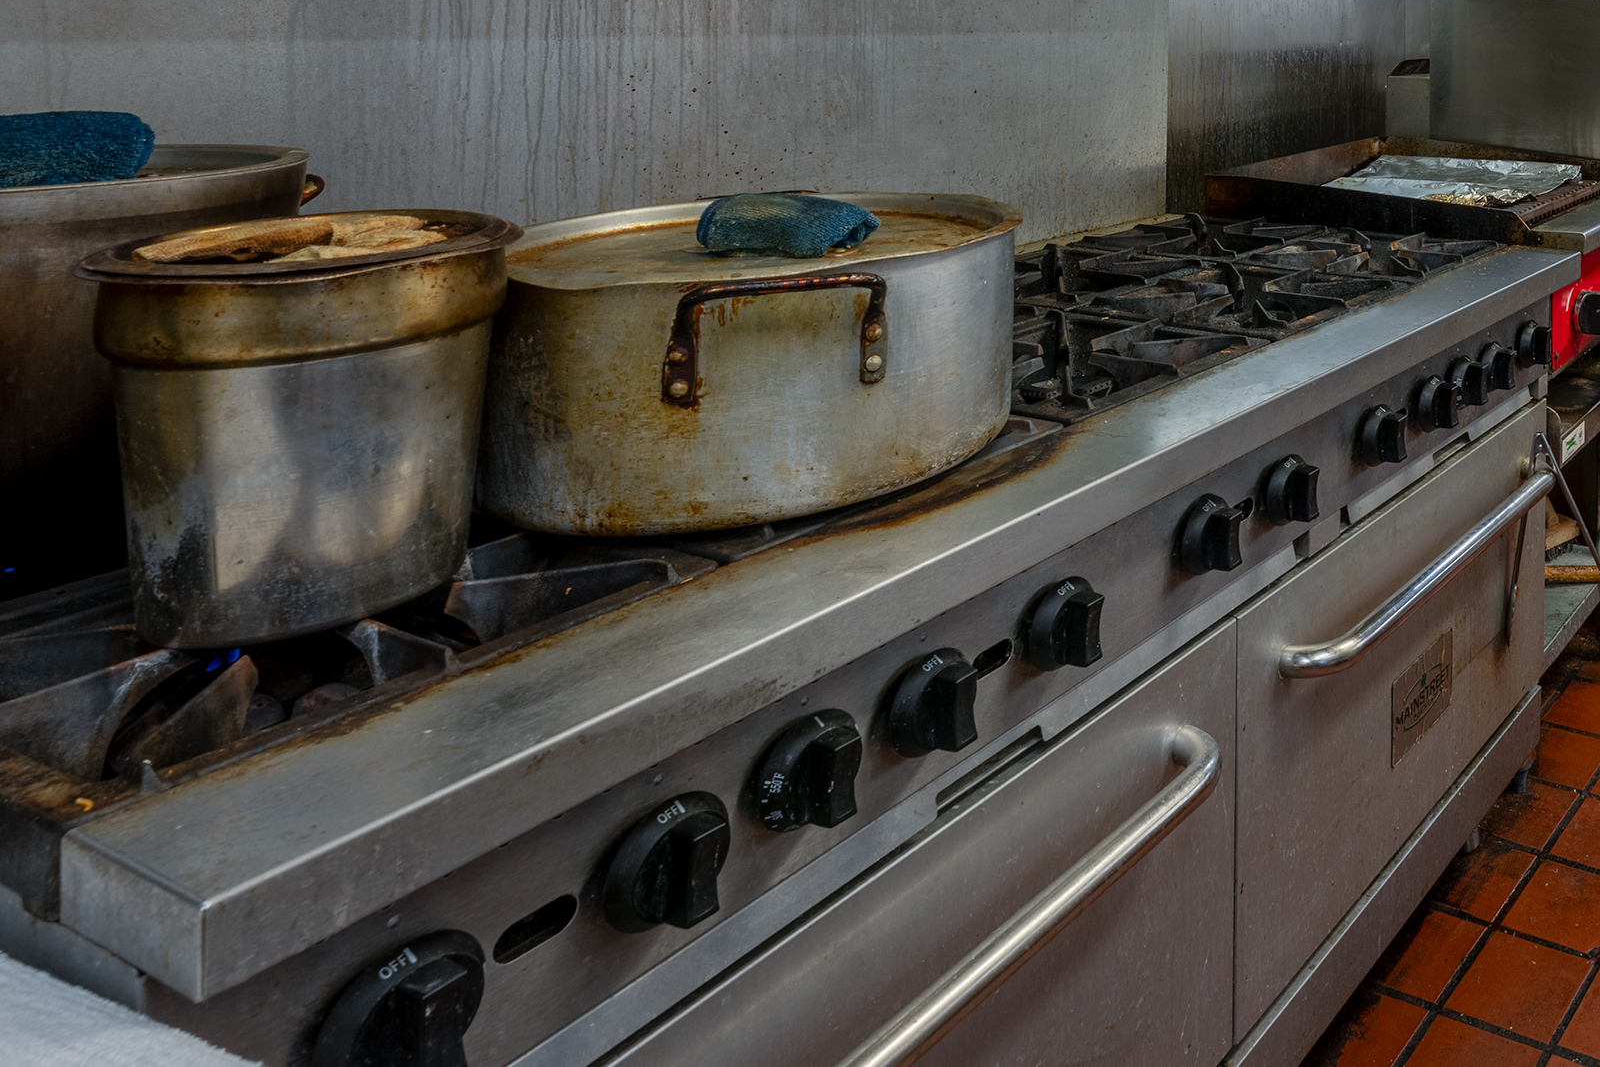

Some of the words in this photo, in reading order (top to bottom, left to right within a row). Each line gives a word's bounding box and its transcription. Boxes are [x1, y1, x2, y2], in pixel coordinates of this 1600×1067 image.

[1284, 458, 1295, 468] OFF
[1202, 501, 1214, 512] OFF
[1057, 584, 1072, 596] OFF
[922, 656, 939, 673] OFF
[1395, 664, 1451, 725] MAINSTREET
[656, 804, 679, 824] OFF
[378, 952, 407, 980] OFF
